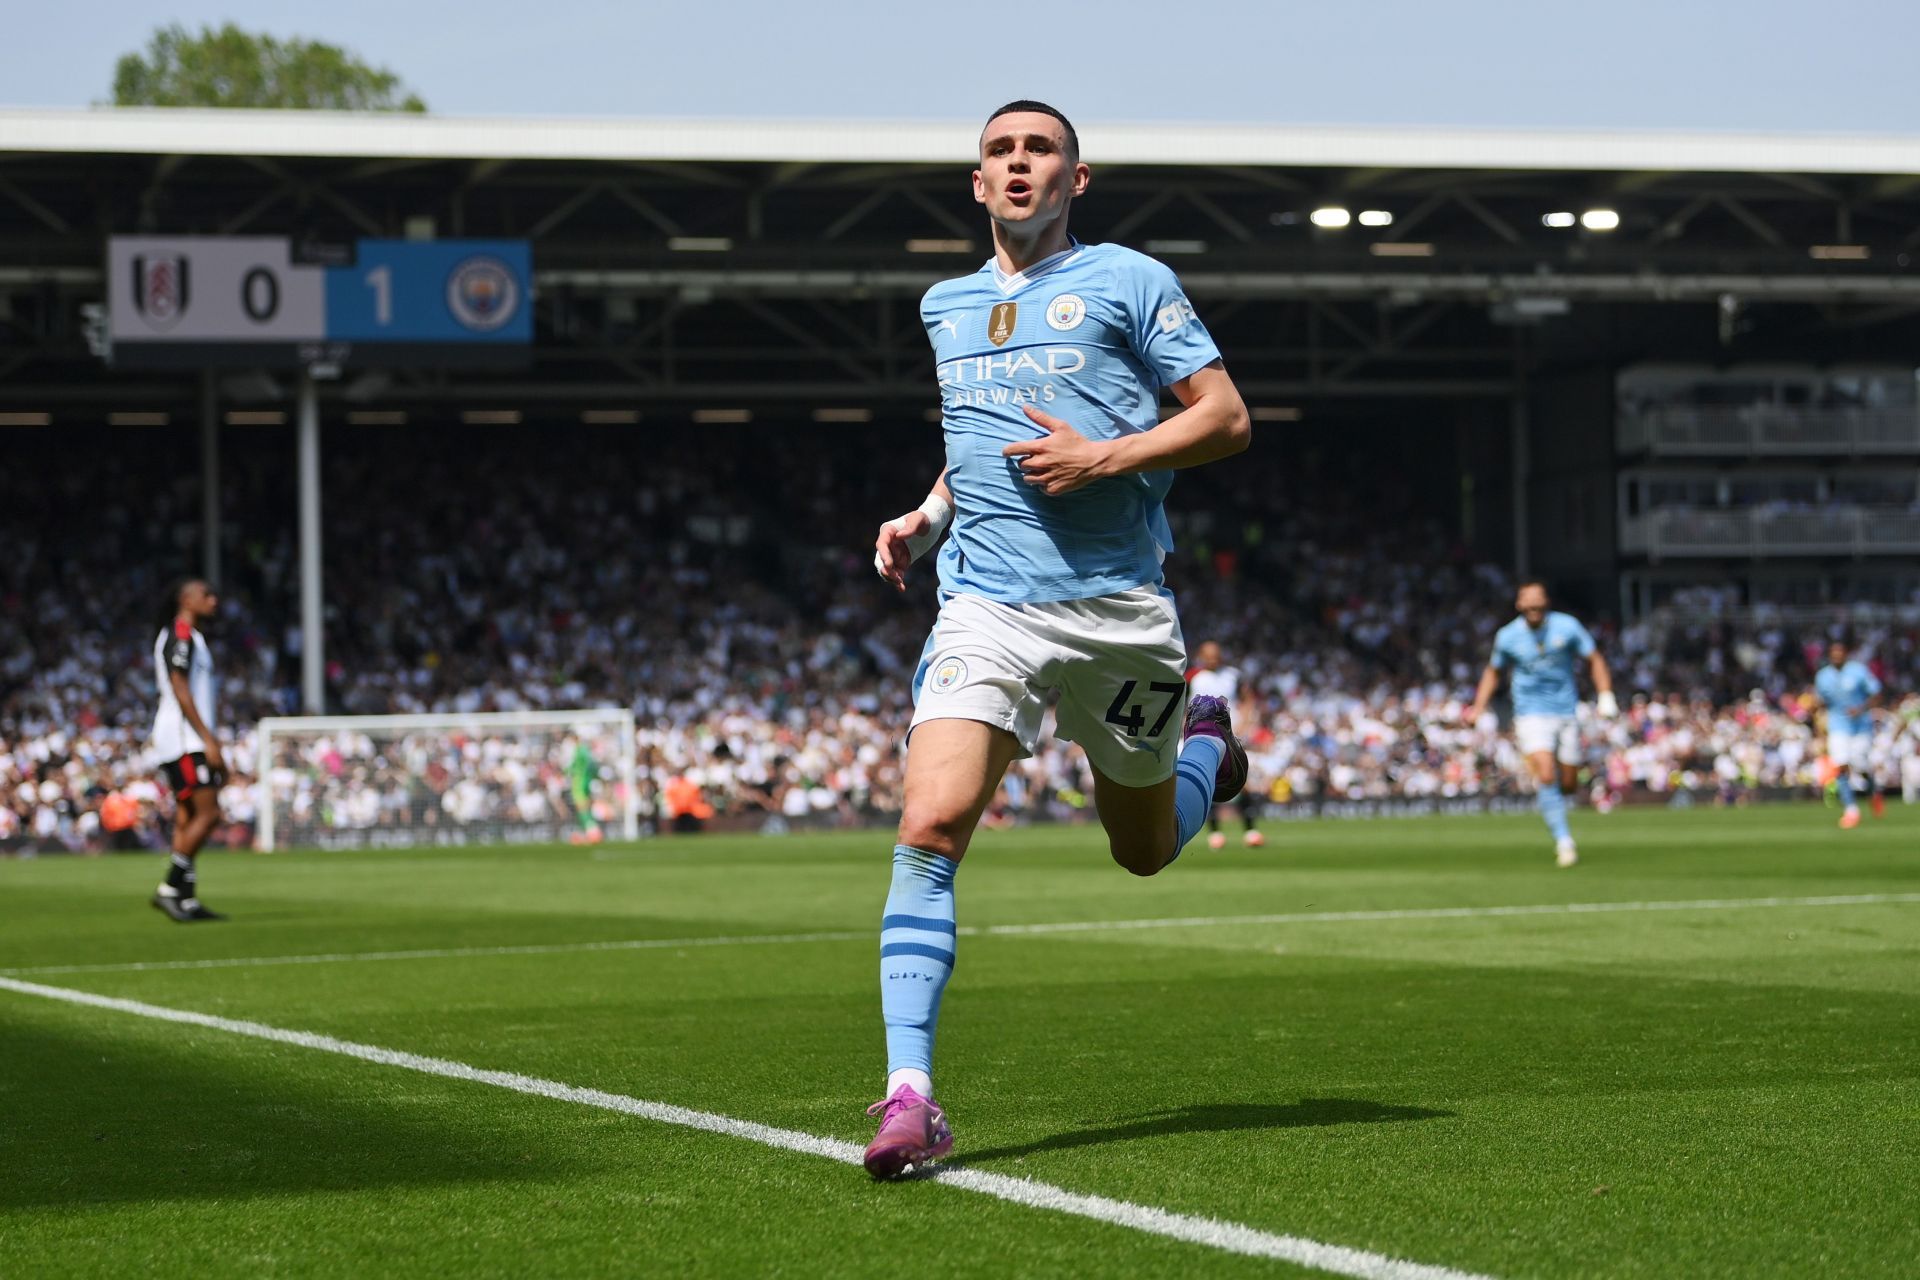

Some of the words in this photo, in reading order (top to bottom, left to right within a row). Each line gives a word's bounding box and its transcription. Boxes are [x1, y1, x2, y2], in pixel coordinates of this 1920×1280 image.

[241, 265, 281, 324] 0
[366, 266, 392, 325] 1
[954, 384, 1056, 407] AIRWAYS
[1105, 680, 1186, 737] 47
[890, 972, 933, 982] CITY
